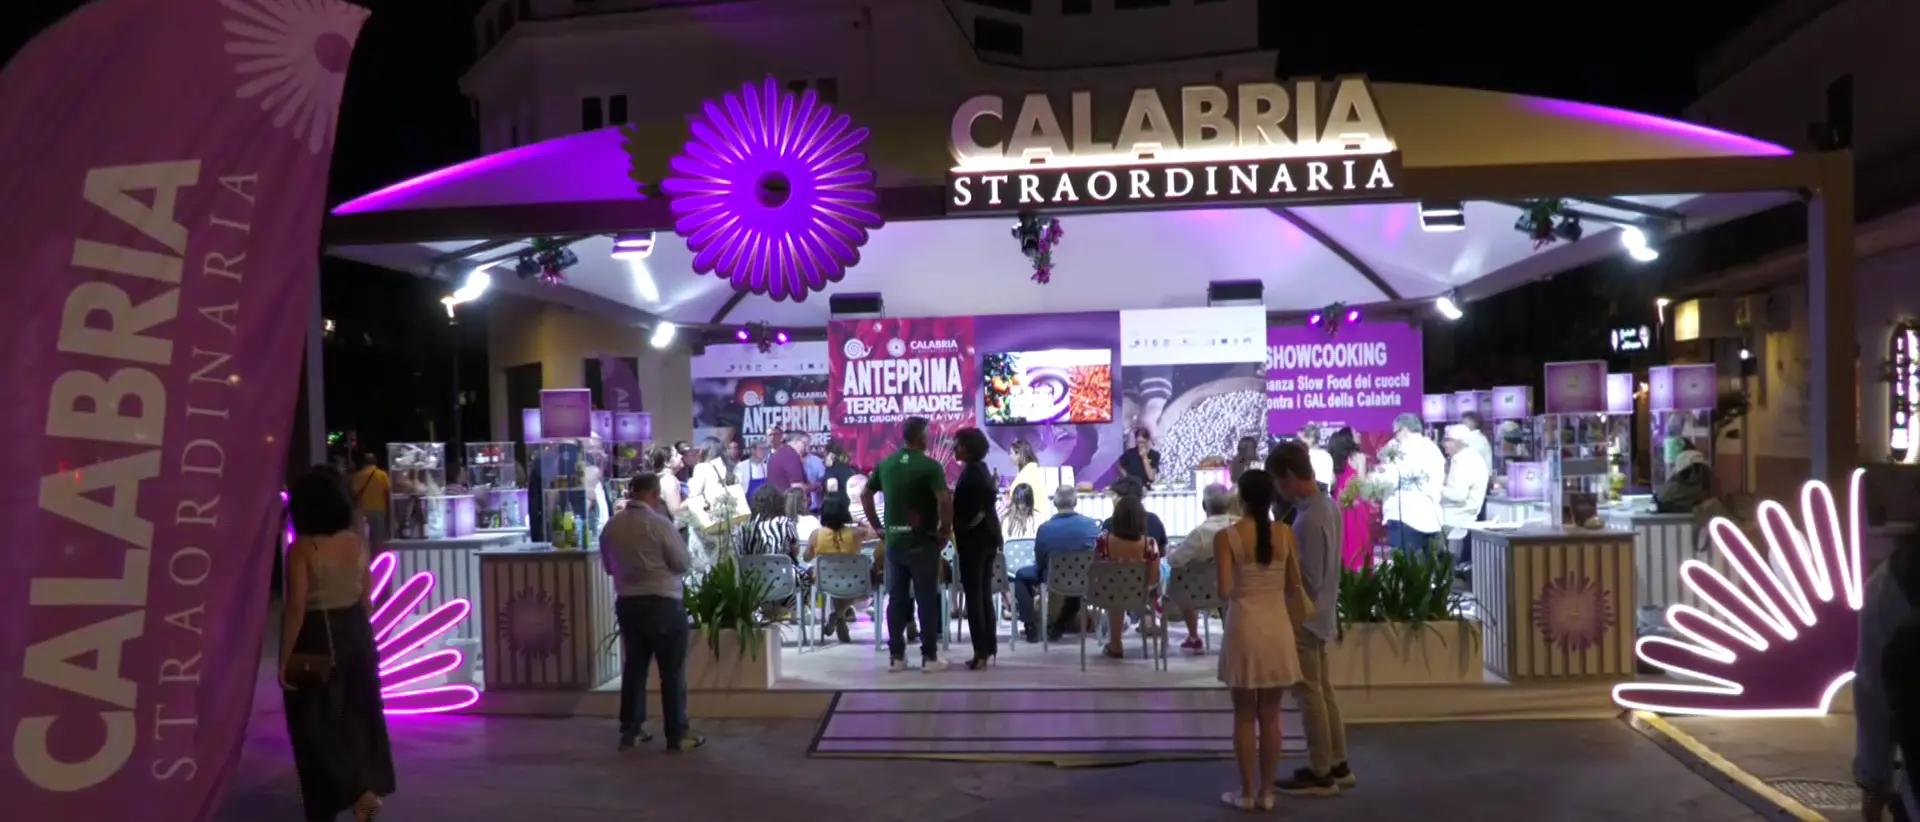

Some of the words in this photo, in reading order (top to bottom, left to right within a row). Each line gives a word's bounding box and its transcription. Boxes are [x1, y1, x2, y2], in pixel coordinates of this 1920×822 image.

[950, 78, 1390, 164] CALABRIA
[952, 158, 1395, 206] STRAORDINARIA
[910, 339, 958, 350] CALABRIA
[1266, 342, 1388, 370] SHOWCOOKING
[843, 357, 963, 396] ANTEPRIMA
[1297, 375, 1324, 391] Slow
[1326, 374, 1352, 390] Food
[1374, 372, 1411, 388] cuochi
[843, 396, 900, 415] TERRA
[902, 394, 963, 414] MADRE
[1303, 392, 1327, 409] GAL
[1356, 390, 1402, 408] Calabria
[742, 404, 831, 434] ANTEPRIMA
[869, 413, 904, 422] GIUGNO
[13, 158, 202, 792] CALABRIA
[152, 170, 259, 783] STRAORDINARIA
